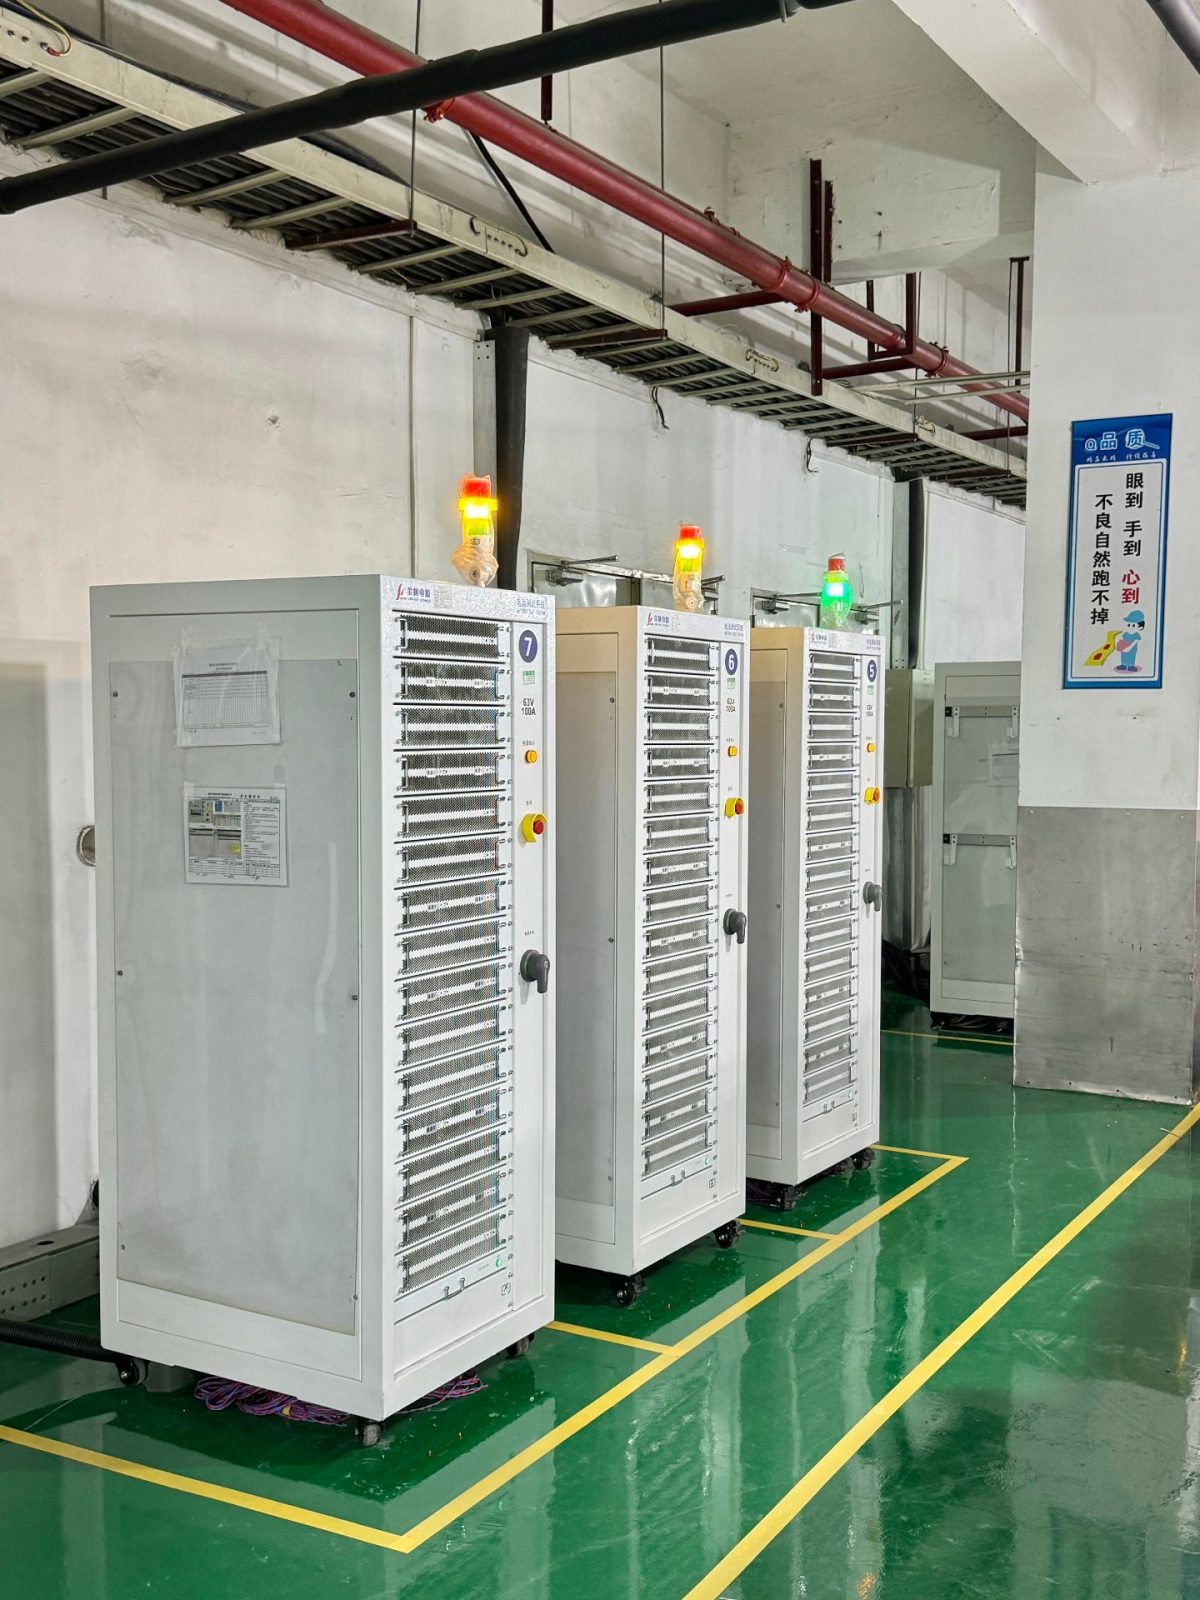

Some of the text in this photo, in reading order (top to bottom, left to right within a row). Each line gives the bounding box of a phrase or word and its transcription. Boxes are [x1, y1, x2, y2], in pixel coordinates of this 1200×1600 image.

[1121, 472, 1144, 604] 眼到 手到 心到
[1090, 494, 1113, 625] 不良自然跑不掉
[524, 637, 533, 656] 7
[728, 654, 735, 670] 6
[869, 664, 875, 678] 5
[522, 698, 534, 706] 63V
[521, 707, 536, 715] 100A
